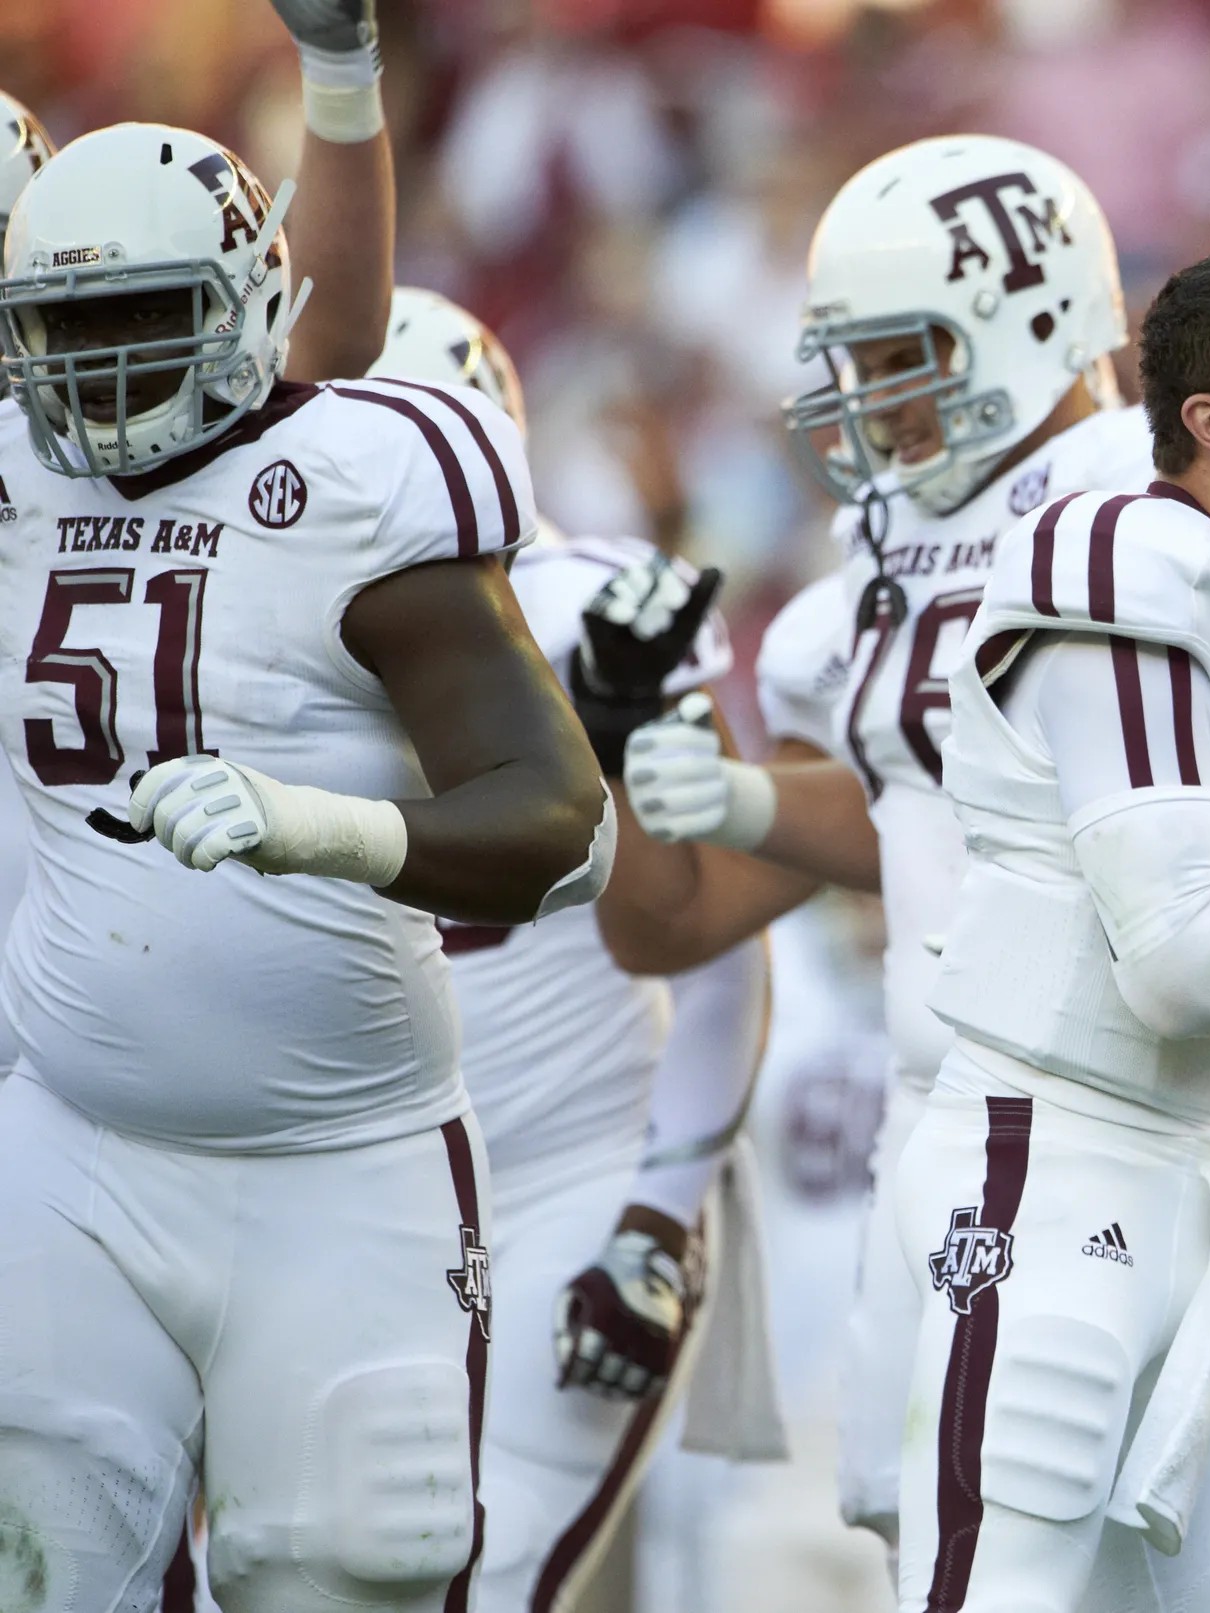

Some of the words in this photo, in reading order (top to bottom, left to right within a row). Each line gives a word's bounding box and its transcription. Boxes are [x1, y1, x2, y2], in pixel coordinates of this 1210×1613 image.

[215, 283, 254, 336] Ridell
[252, 465, 301, 523] SEC
[57, 516, 145, 553] TEXAS
[150, 519, 225, 558] A&M
[23, 566, 219, 786] 51
[1081, 1244, 1134, 1268] adidas
